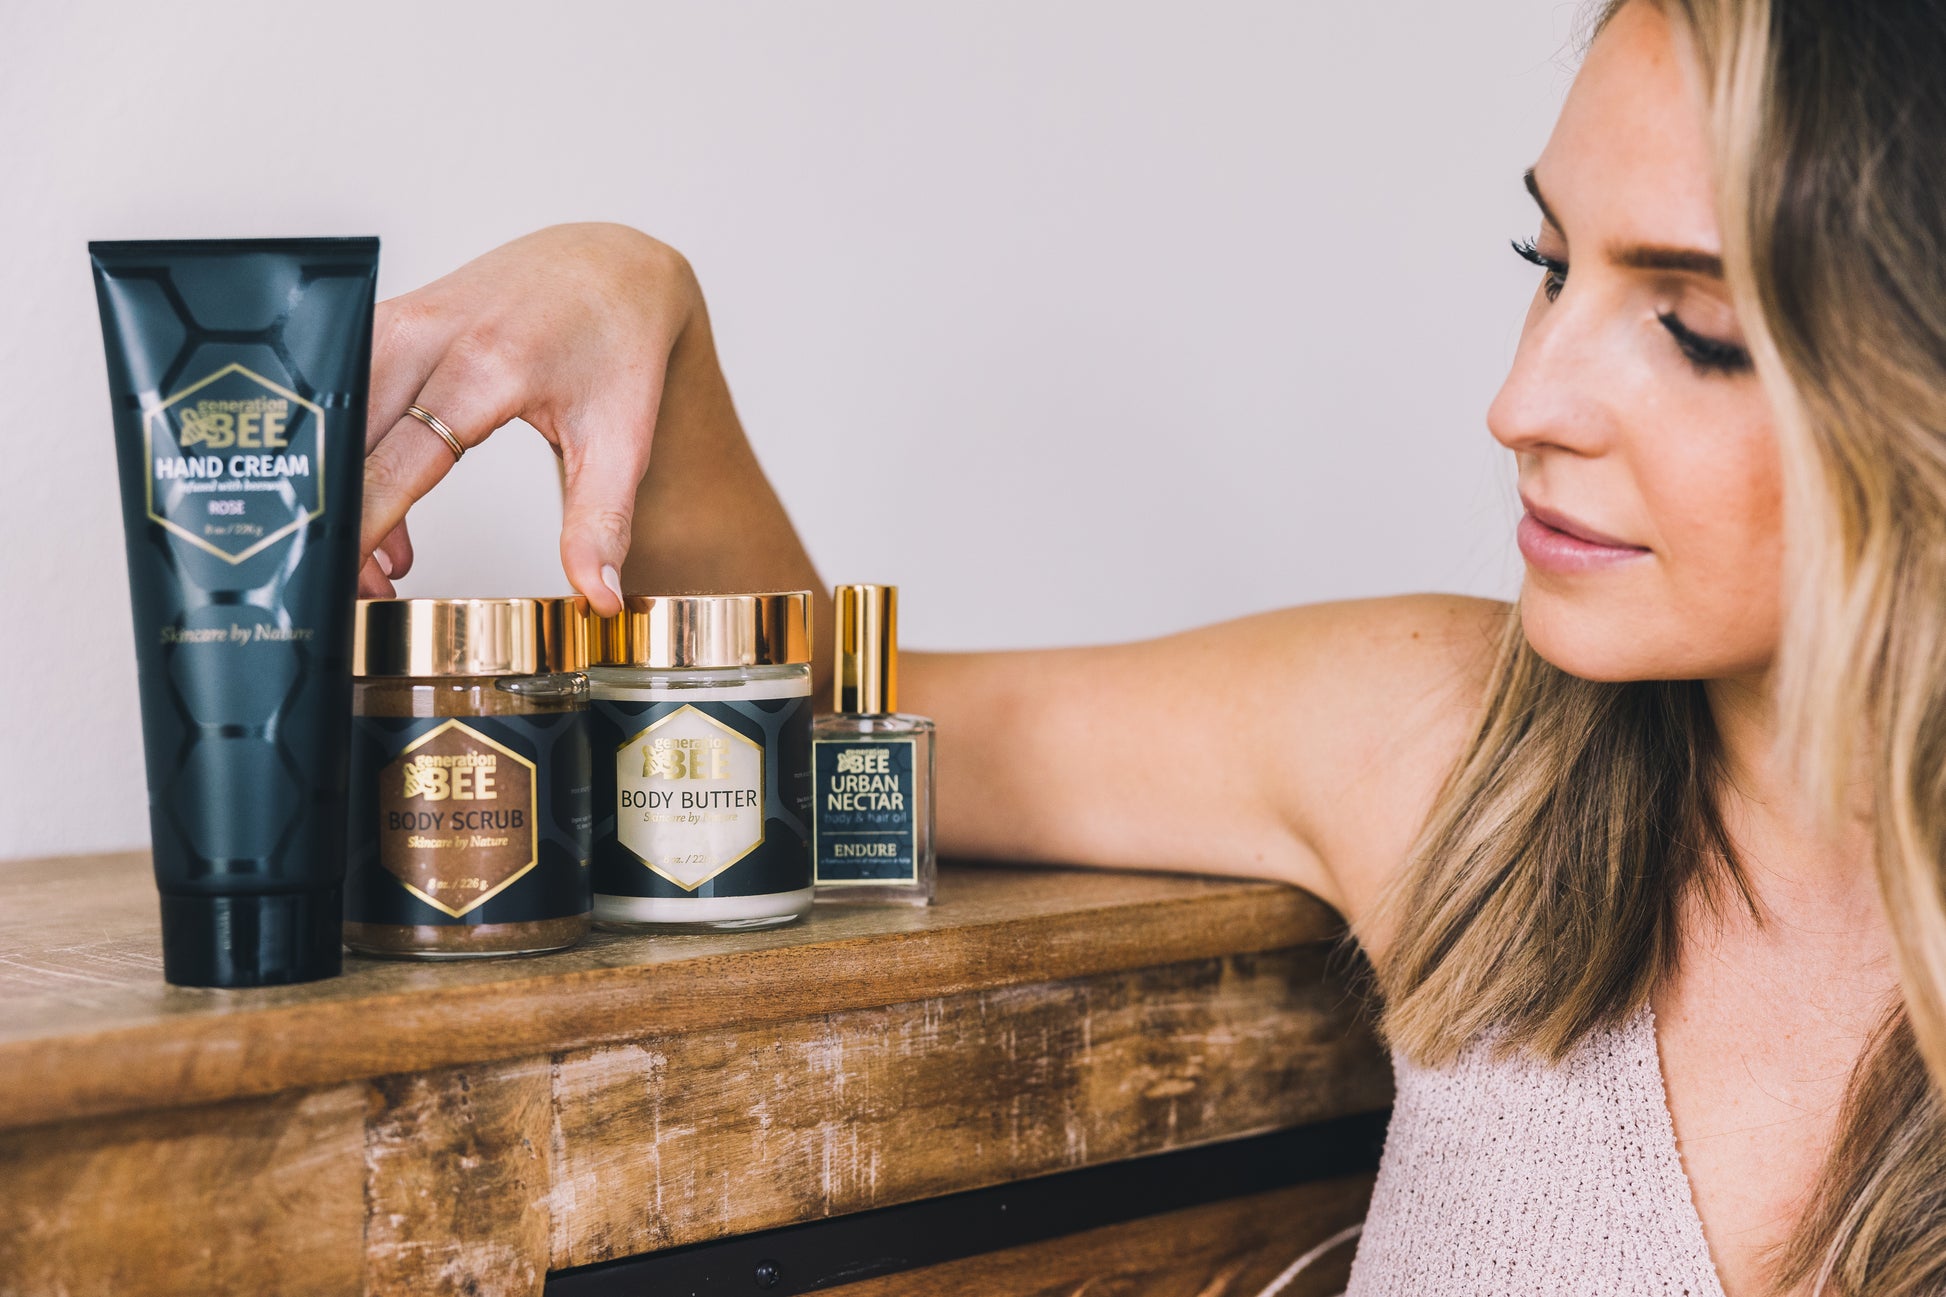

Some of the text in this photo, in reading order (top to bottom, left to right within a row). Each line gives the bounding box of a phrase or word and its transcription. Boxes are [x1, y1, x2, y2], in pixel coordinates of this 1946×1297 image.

[198, 396, 287, 416] generation
[206, 413, 288, 448] BEE
[155, 454, 309, 479] HAND CREAM
[208, 500, 245, 515] ROSE
[231, 623, 251, 647] by
[415, 751, 497, 770] generation
[663, 749, 731, 780] BEE
[850, 754, 890, 773] BEE
[424, 766, 498, 801] BEE
[831, 775, 899, 793] URBAN
[621, 790, 757, 809] BODY BUTTER
[827, 793, 904, 811] NECTAR
[389, 809, 525, 831] BODY SCRUB
[643, 811, 686, 823] Sinare
[688, 811, 701, 825] by
[824, 813, 851, 824] body
[868, 812, 889, 823] hair
[892, 812, 907, 823] oil
[407, 835, 509, 851] Skincare by Nature
[834, 844, 897, 857] ENDURE
[460, 878, 479, 889] 226
